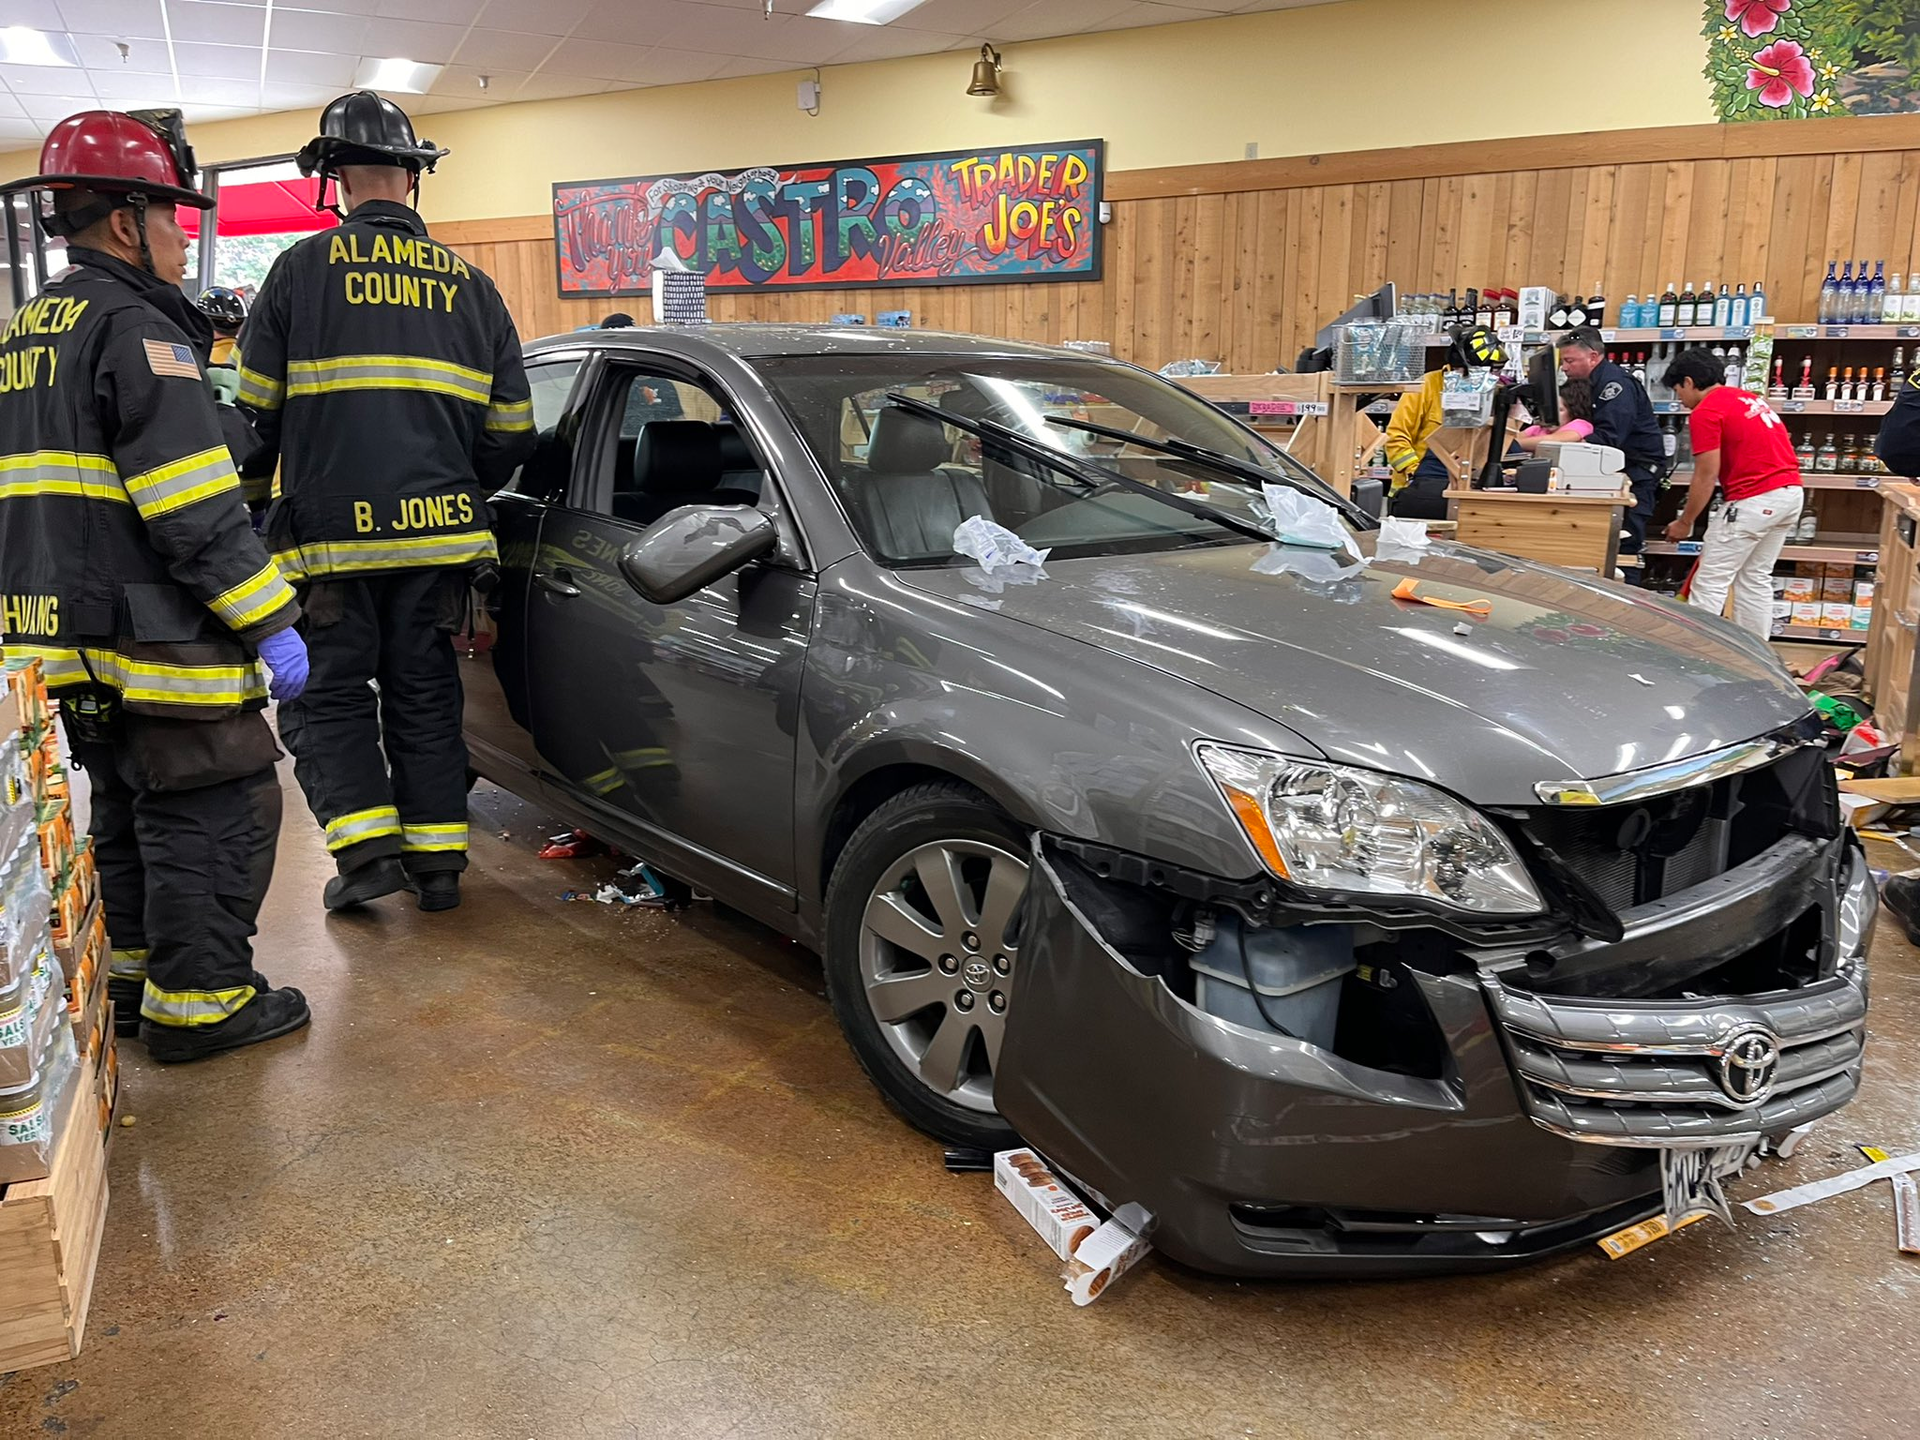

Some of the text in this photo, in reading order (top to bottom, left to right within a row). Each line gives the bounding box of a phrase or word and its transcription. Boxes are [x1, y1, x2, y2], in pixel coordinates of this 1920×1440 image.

[648, 187, 661, 203] For
[950, 152, 1088, 205] TRADER
[555, 181, 654, 272] Thank
[656, 167, 936, 280] CASTRO
[978, 193, 1082, 260] JOE'S
[329, 234, 470, 281] ALAMEDA
[879, 217, 979, 279] Valley
[345, 271, 458, 314] COUNTY
[0, 297, 89, 344] LAMEDA
[0, 346, 60, 393] OUNTY
[354, 493, 474, 533] B. JONES
